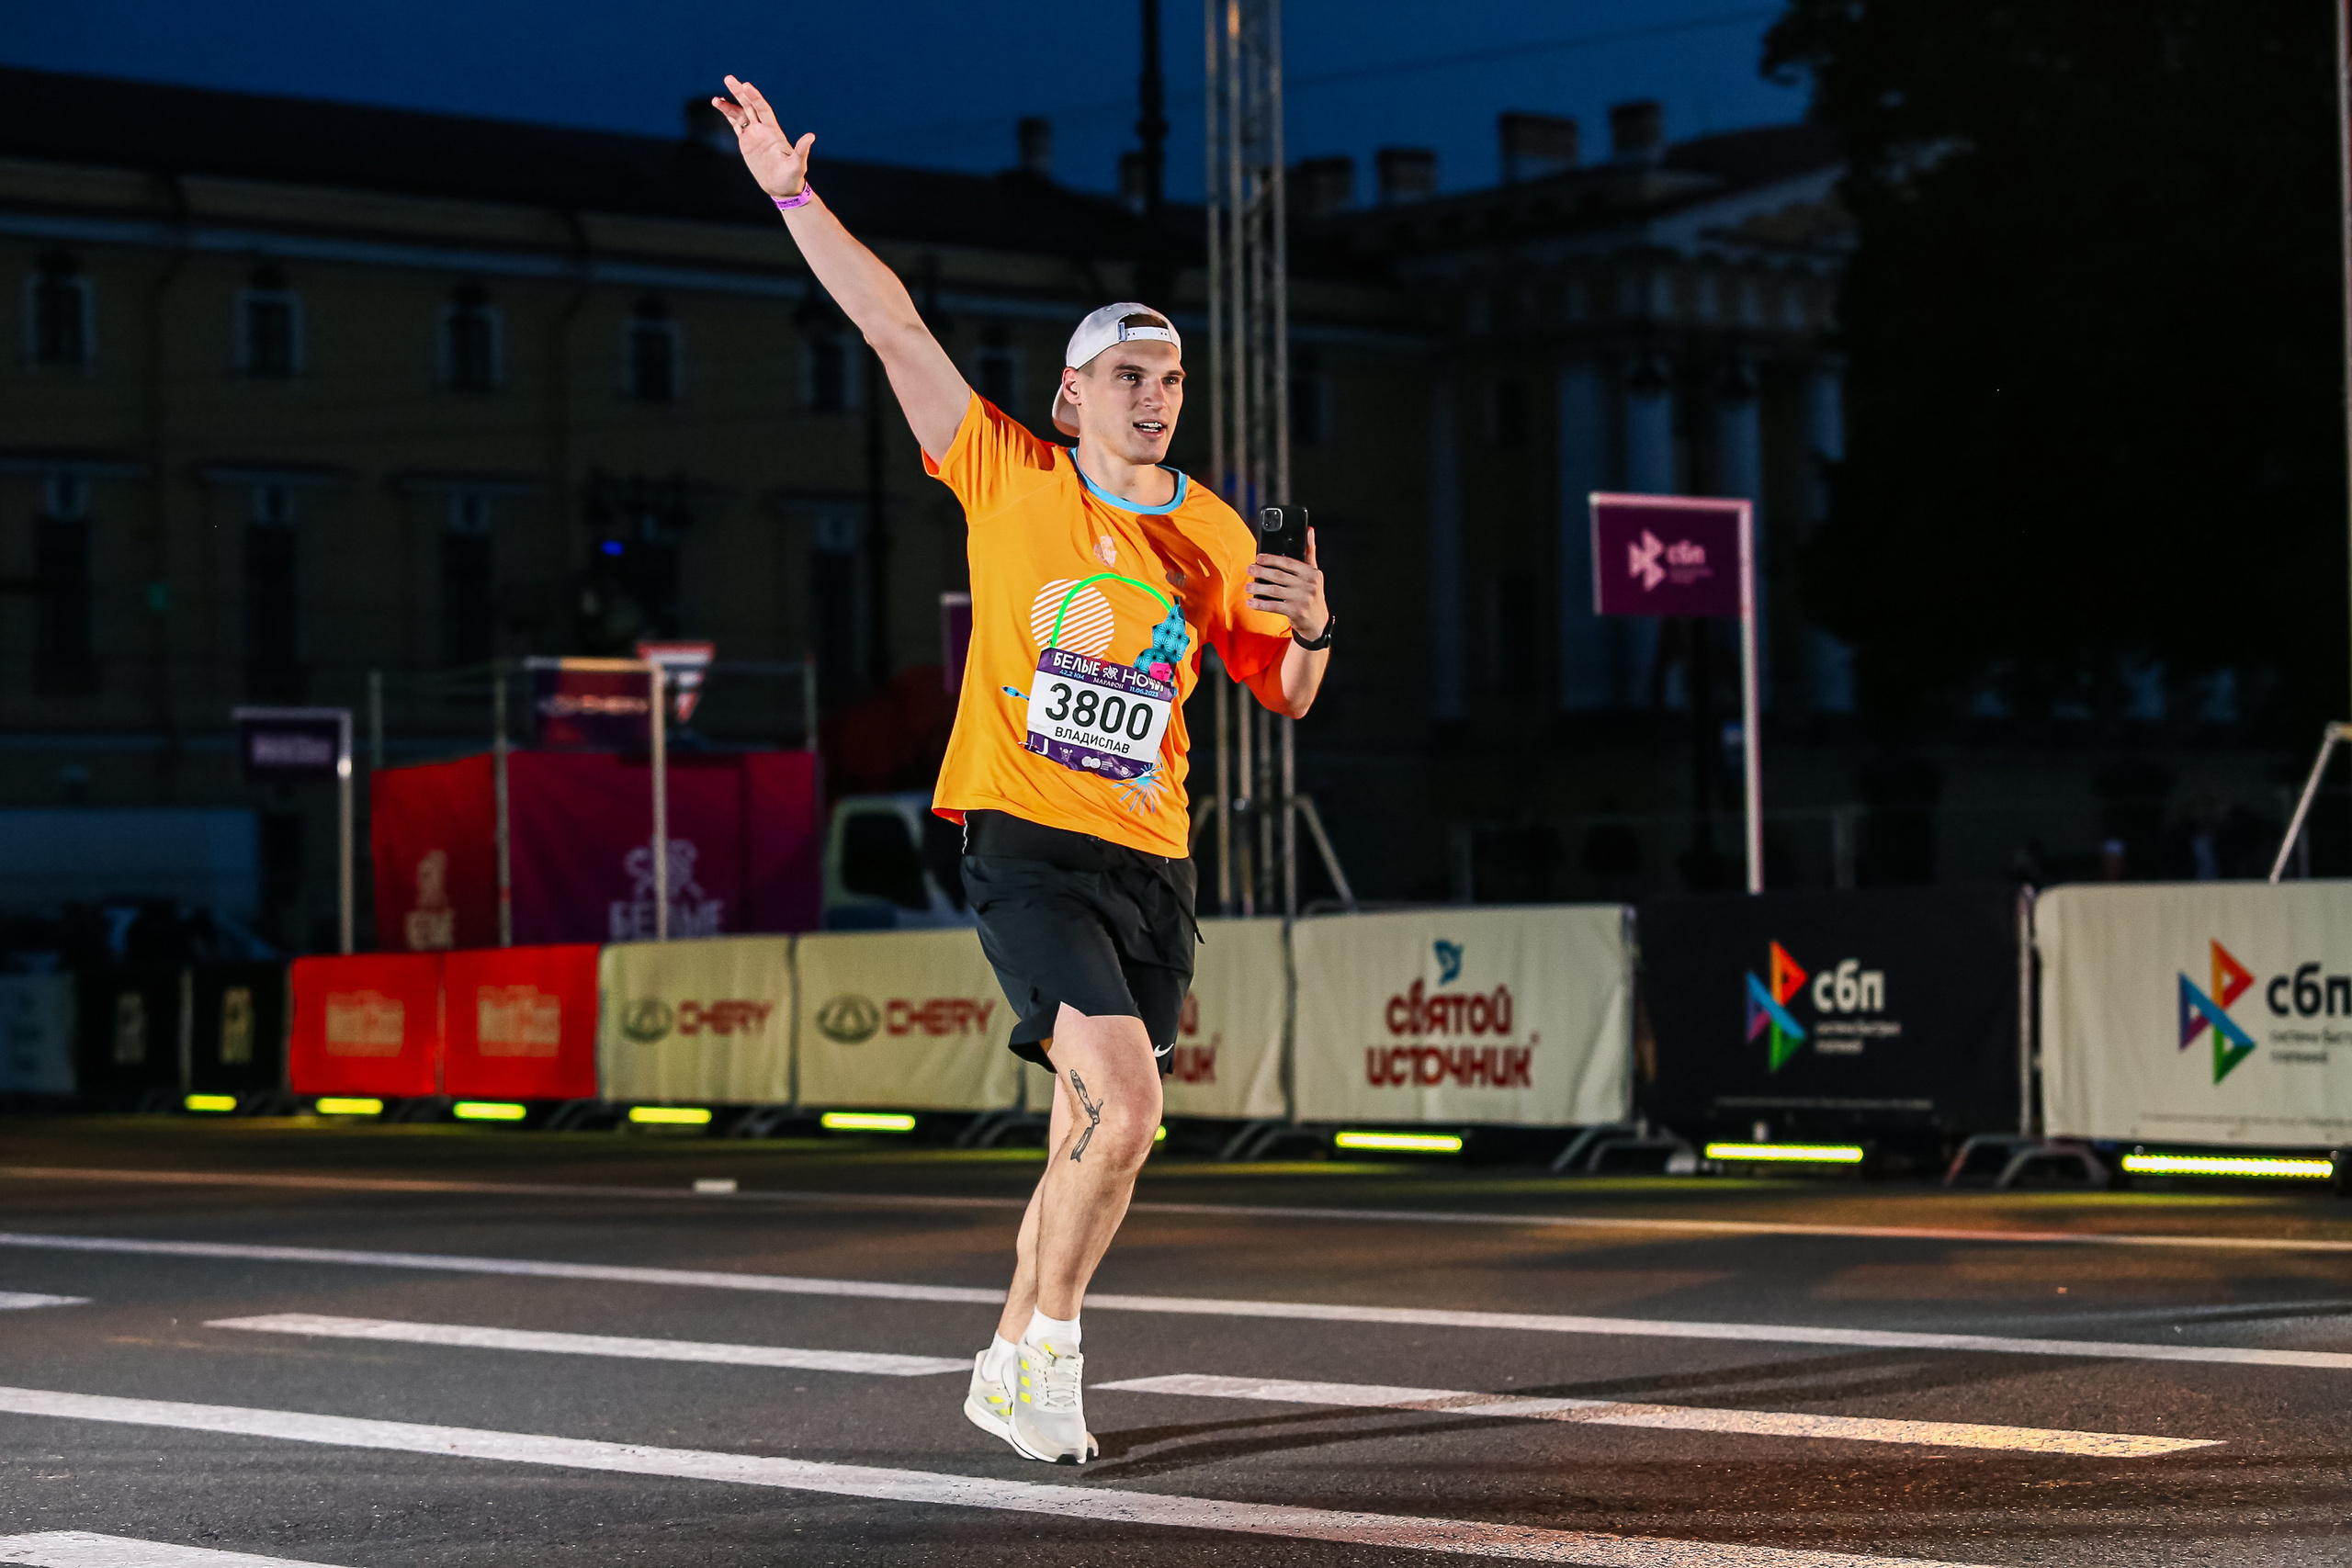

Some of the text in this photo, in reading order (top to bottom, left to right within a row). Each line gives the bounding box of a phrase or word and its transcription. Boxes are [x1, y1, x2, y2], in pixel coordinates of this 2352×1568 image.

[1053, 651, 1102, 677] БЕЛЫЕ
[1045, 682, 1153, 740] 3800
[1055, 727, 1130, 753] ВЛАДИСЛАВ
[679, 999, 773, 1036] CHERY
[887, 998, 996, 1036] CHERY
